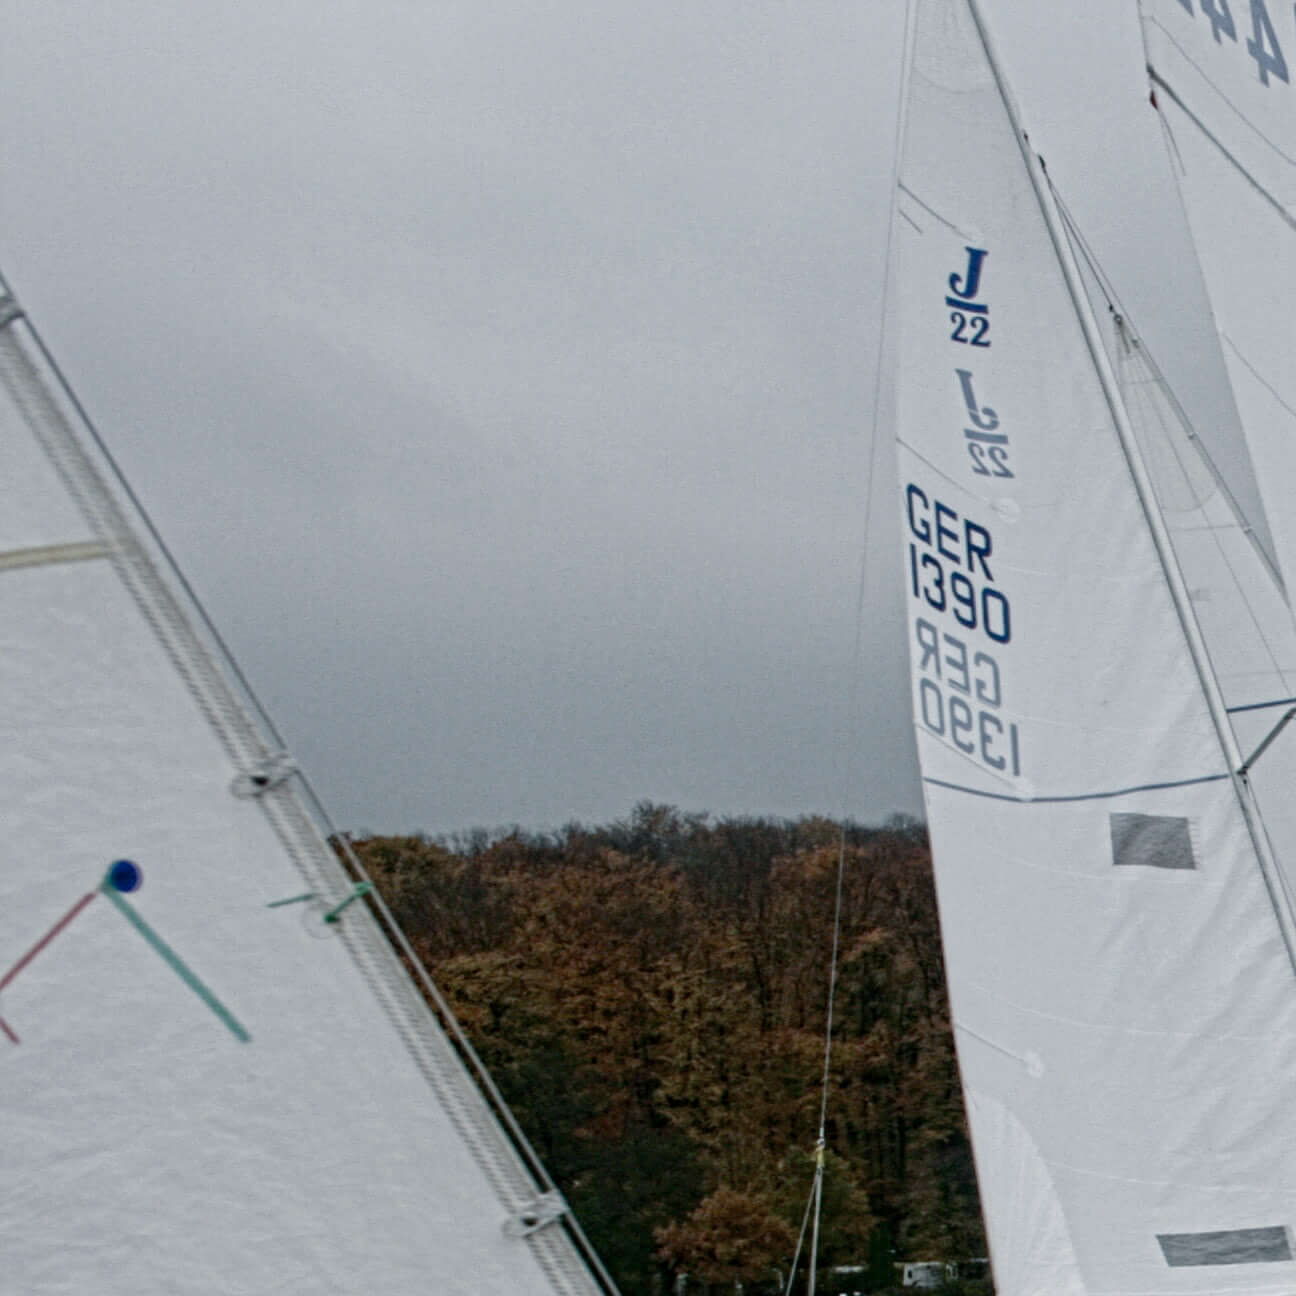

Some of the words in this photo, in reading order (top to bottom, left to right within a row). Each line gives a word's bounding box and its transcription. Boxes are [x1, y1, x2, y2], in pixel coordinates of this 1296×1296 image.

[948, 245, 989, 300] J
[950, 311, 992, 348] 22
[906, 483, 995, 583] GER
[910, 542, 1012, 645] 1390
